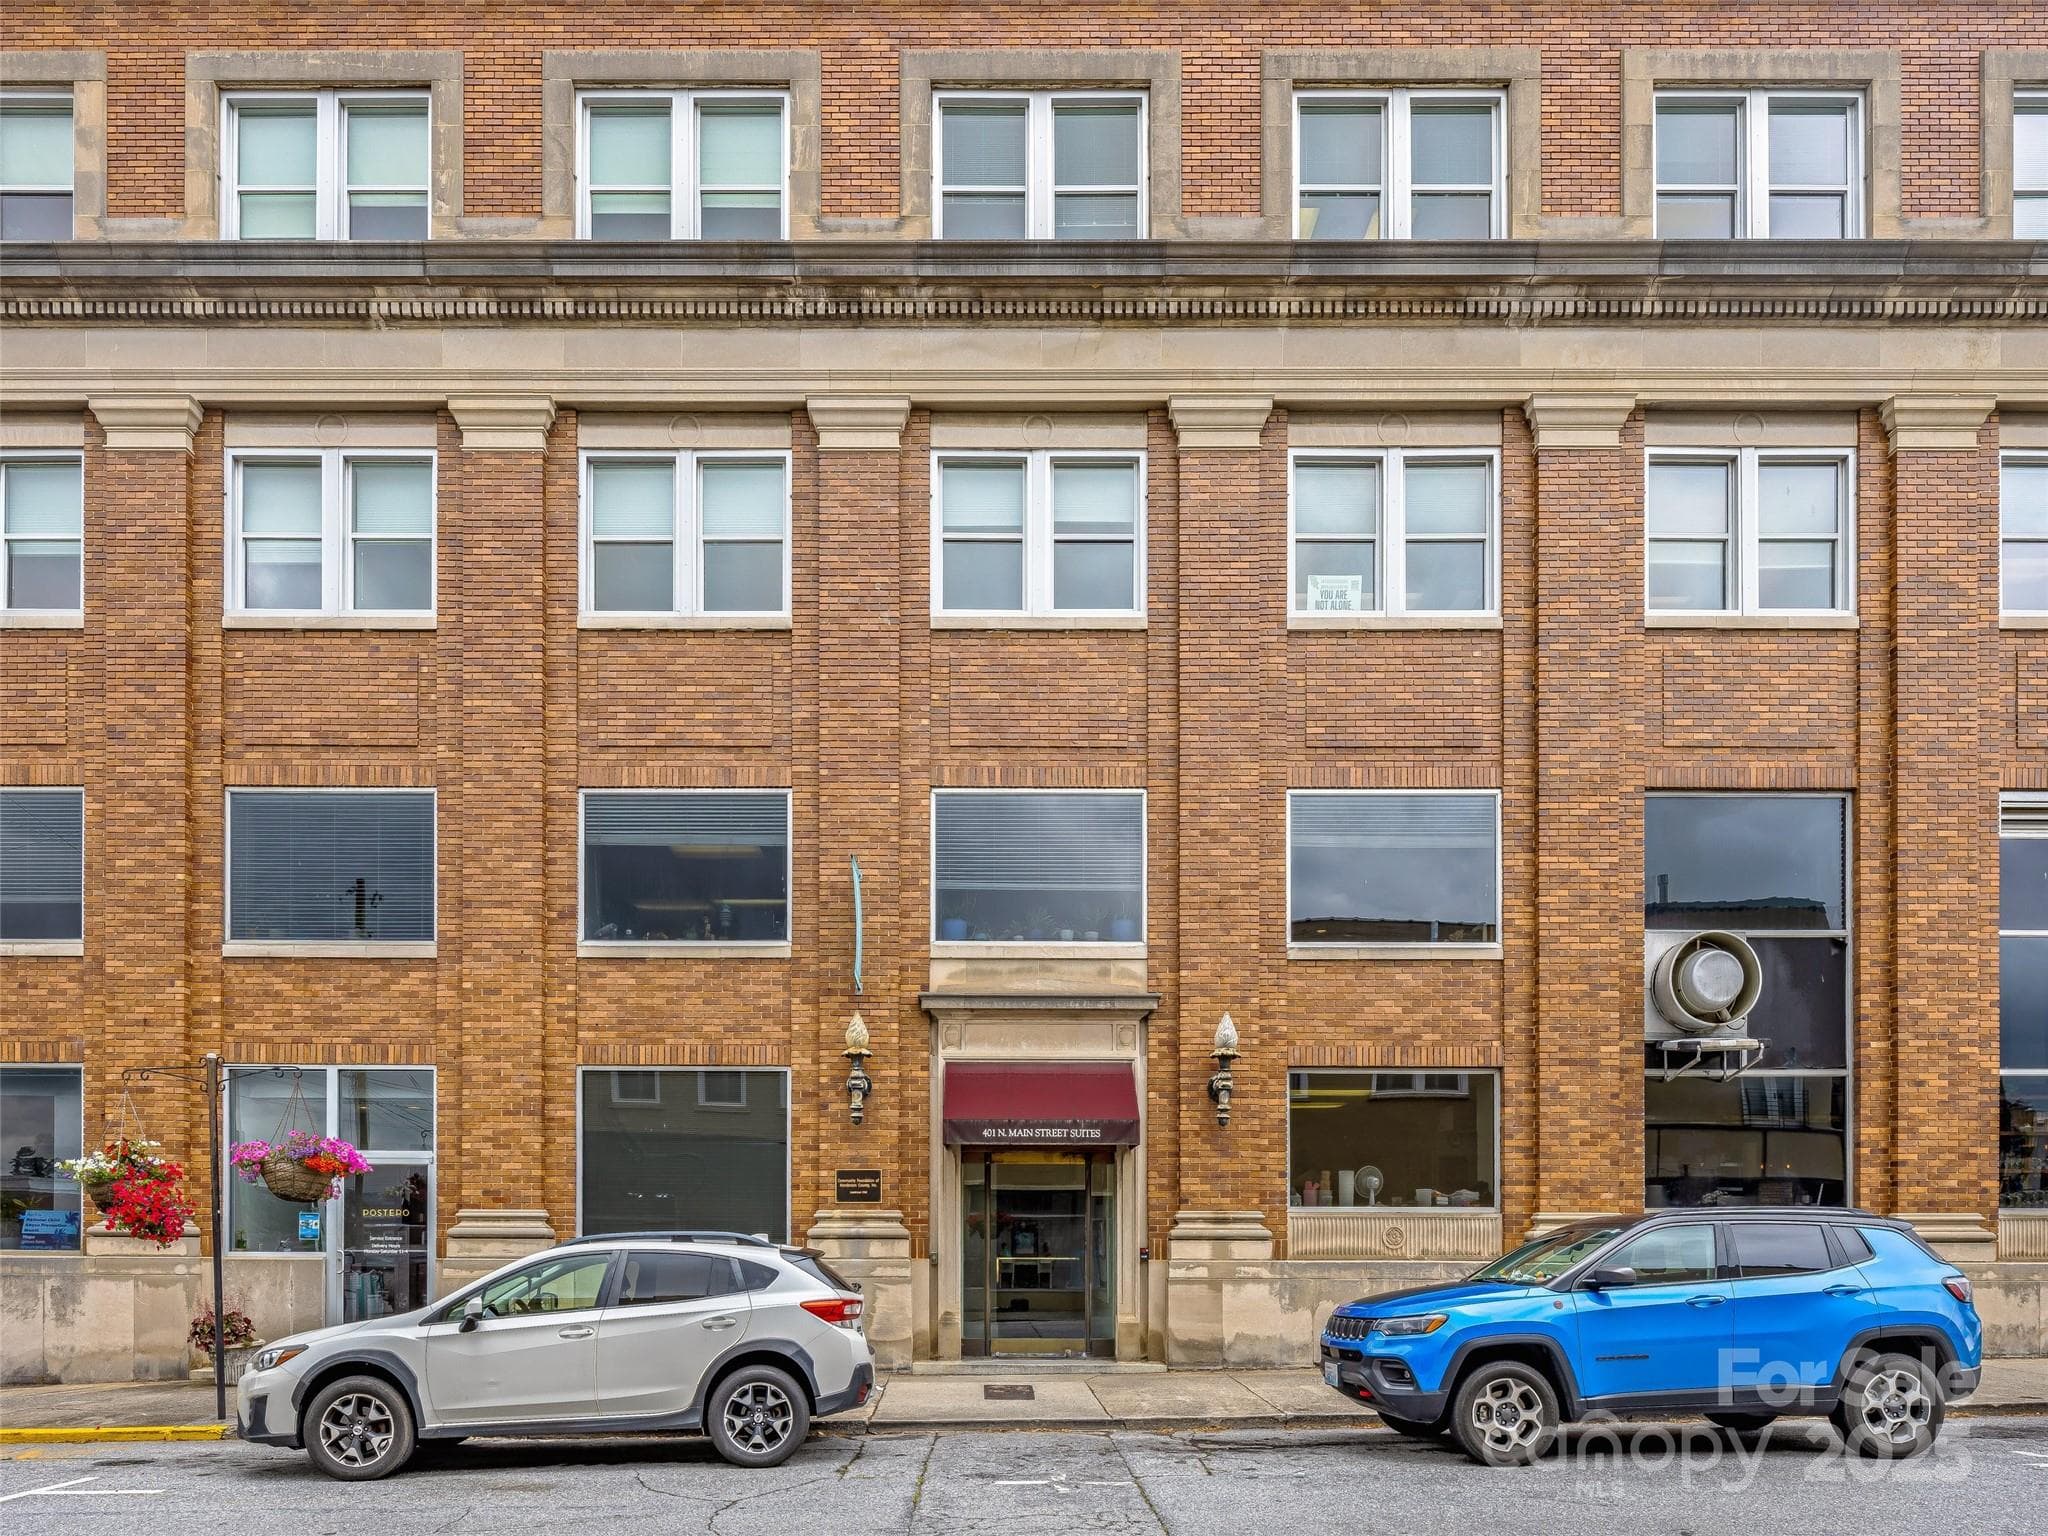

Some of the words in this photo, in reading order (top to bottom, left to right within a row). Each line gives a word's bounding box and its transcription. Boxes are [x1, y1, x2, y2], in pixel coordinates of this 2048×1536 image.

[1320, 590, 1334, 600] YOU
[1335, 590, 1348, 600] ARE
[1315, 600, 1328, 610] NOT
[982, 1129, 996, 1138] 401
[997, 1129, 1007, 1137] N.
[1008, 1129, 1033, 1137] MAIN
[1034, 1129, 1069, 1137] STREET
[1070, 1129, 1101, 1138] SUITES
[362, 1209, 410, 1217] POSTERO
